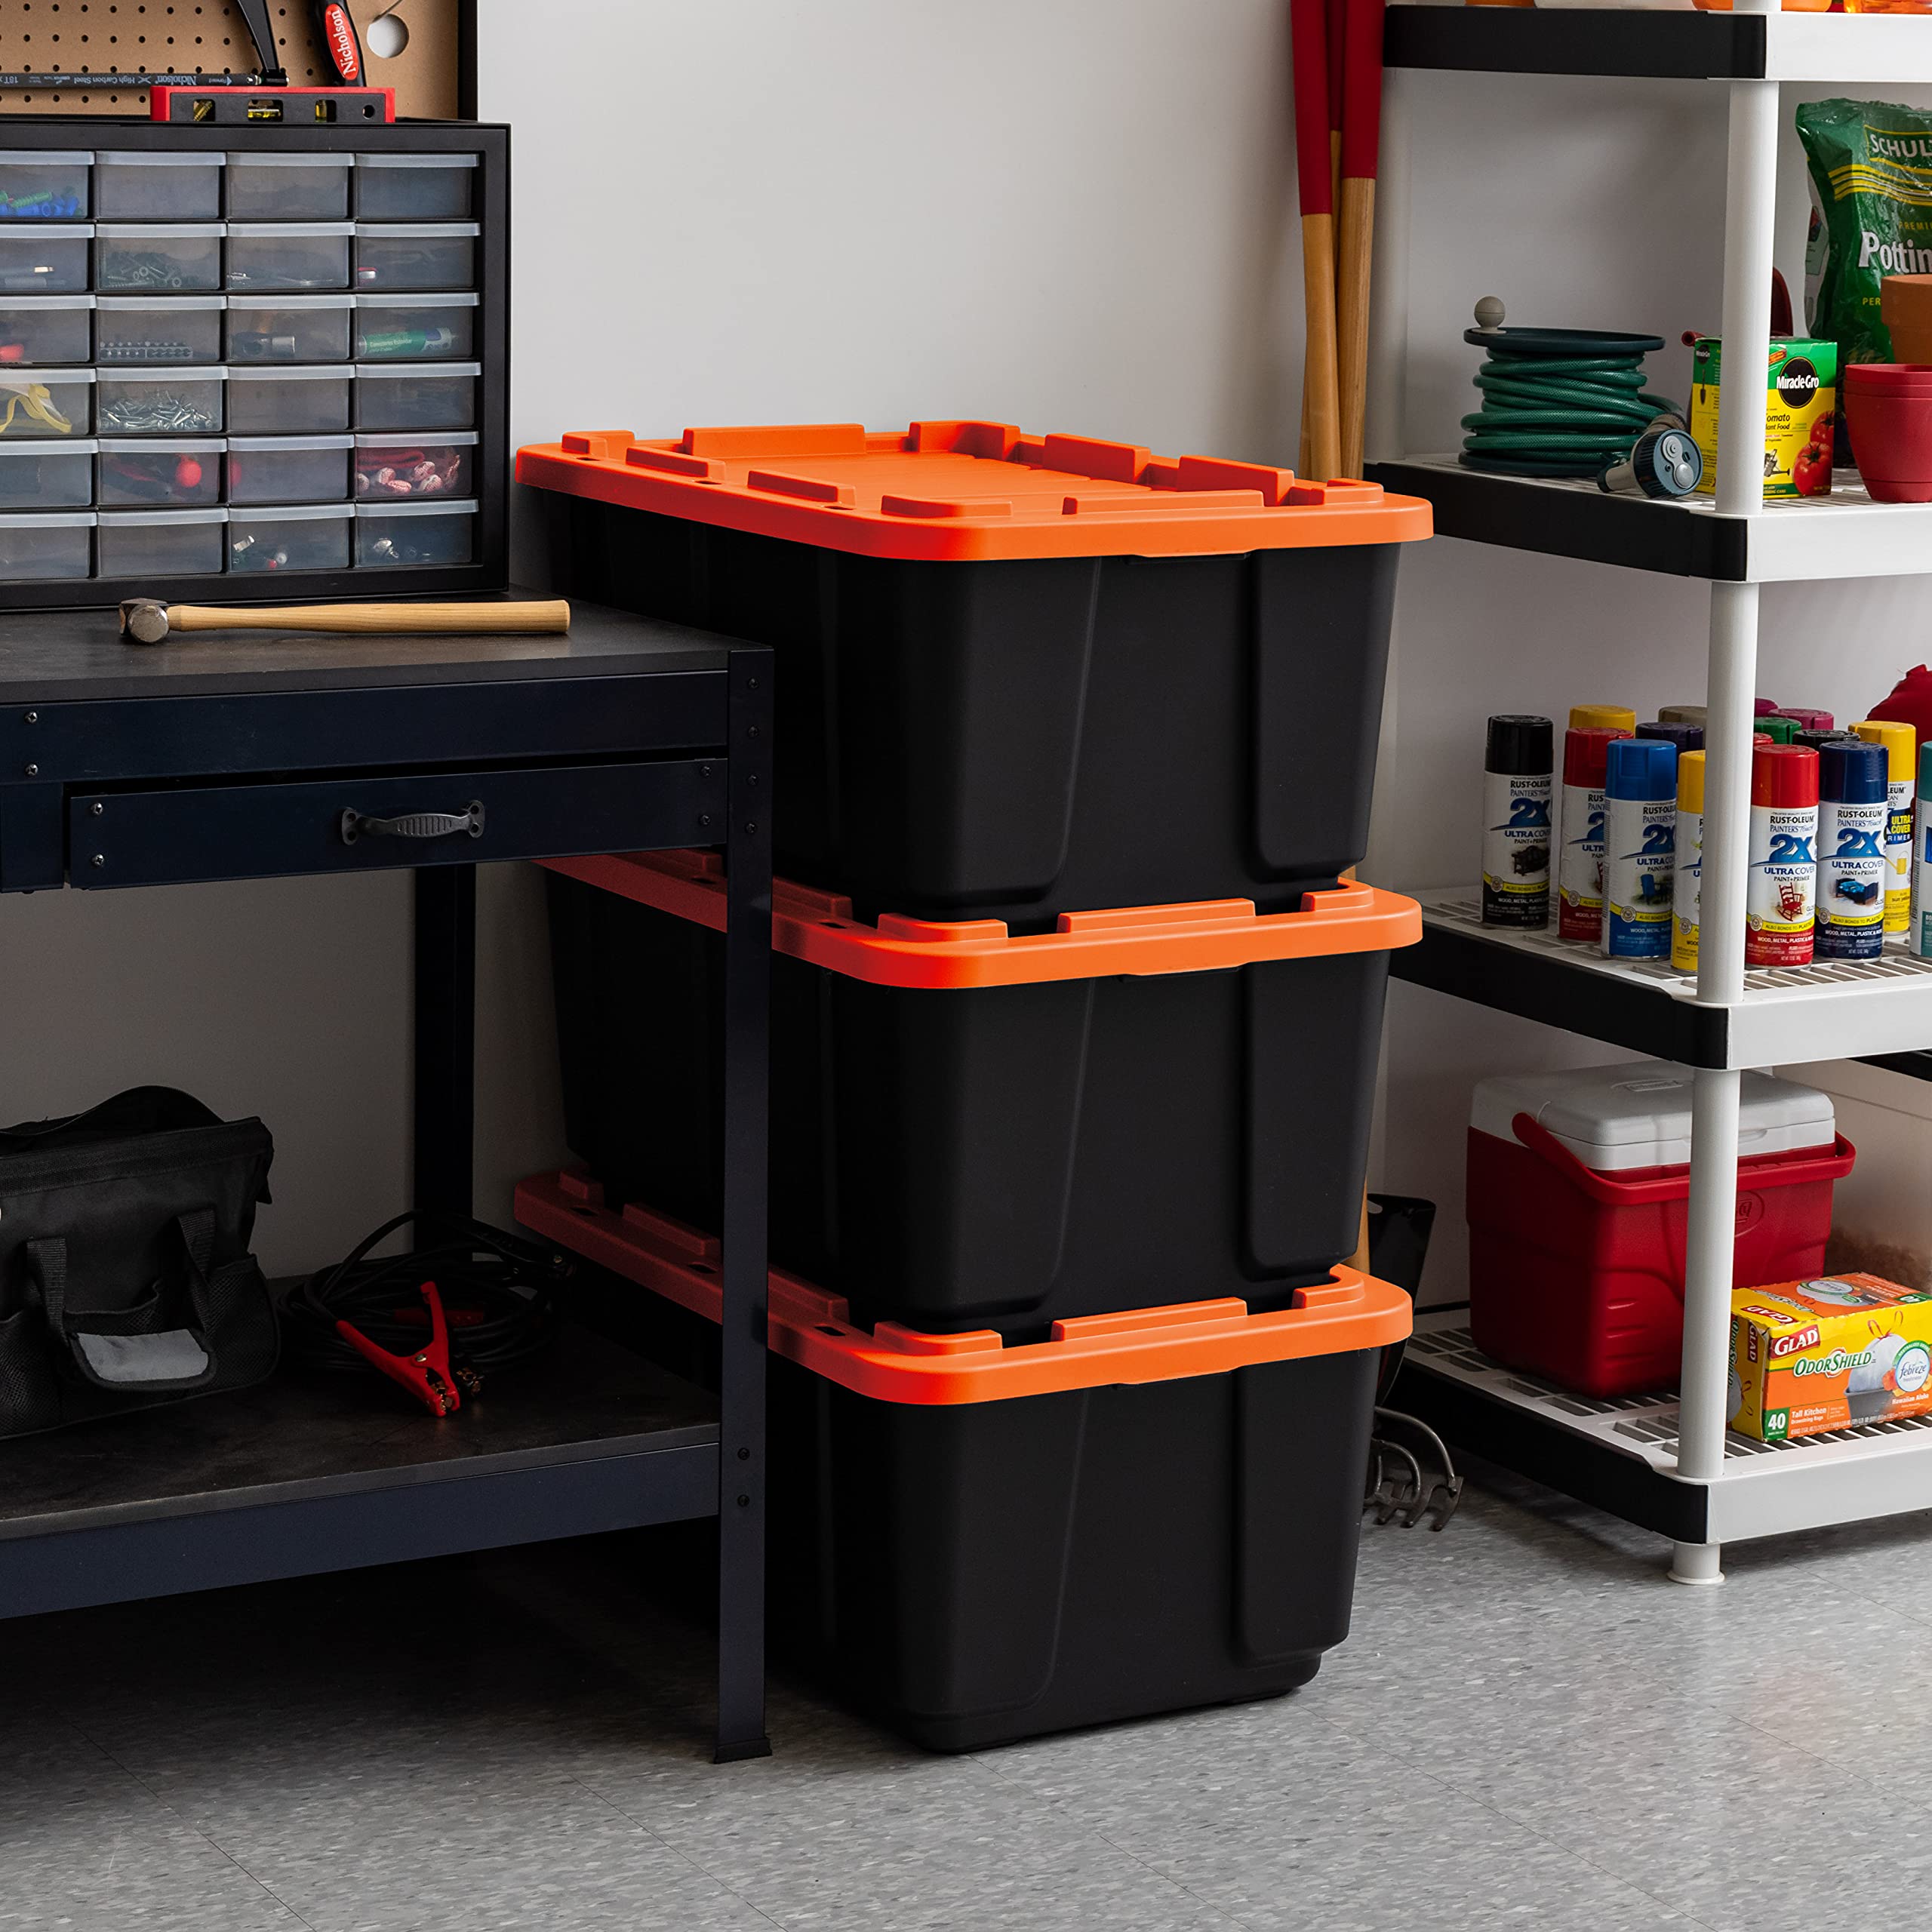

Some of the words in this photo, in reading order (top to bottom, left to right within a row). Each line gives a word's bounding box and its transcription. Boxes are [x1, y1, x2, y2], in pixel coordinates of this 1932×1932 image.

[331, 9, 357, 75] Nicholson
[119, 75, 135, 84] High
[157, 75, 196, 85] Nicholson
[1870, 134, 1932, 158] SCHUL
[1898, 220, 1932, 230] PREMI
[1858, 231, 1932, 273] Pottin
[1862, 297, 1881, 306] PER
[1777, 374, 1820, 389] Miracle-Gro
[1766, 413, 1790, 423] omato
[1777, 422, 1790, 430] Food
[1588, 794, 1604, 802] RUS
[1837, 810, 1882, 818] RUST-OLEUM
[1770, 816, 1814, 824] RUST-OLEUM
[1891, 815, 1911, 825] ULTRA
[1587, 811, 1604, 842] 2
[1890, 824, 1911, 834] COVER
[1836, 827, 1881, 857] 2X
[1769, 834, 1813, 863] 2X
[1636, 857, 1665, 866] ULTRA
[1832, 860, 1862, 869] ULTRA
[1863, 860, 1884, 869] COVER
[1764, 867, 1795, 875] ULTRA
[1795, 866, 1815, 875] COVER
[1746, 1306, 1794, 1323] GLAD
[1749, 1324, 1758, 1361] GLAD
[1774, 1329, 1818, 1356] GLAD
[1900, 1361, 1927, 1380] febreze
[1792, 1410, 1803, 1418] Tall
[1804, 1407, 1826, 1417] Kitchen
[1767, 1412, 1786, 1430] 40
